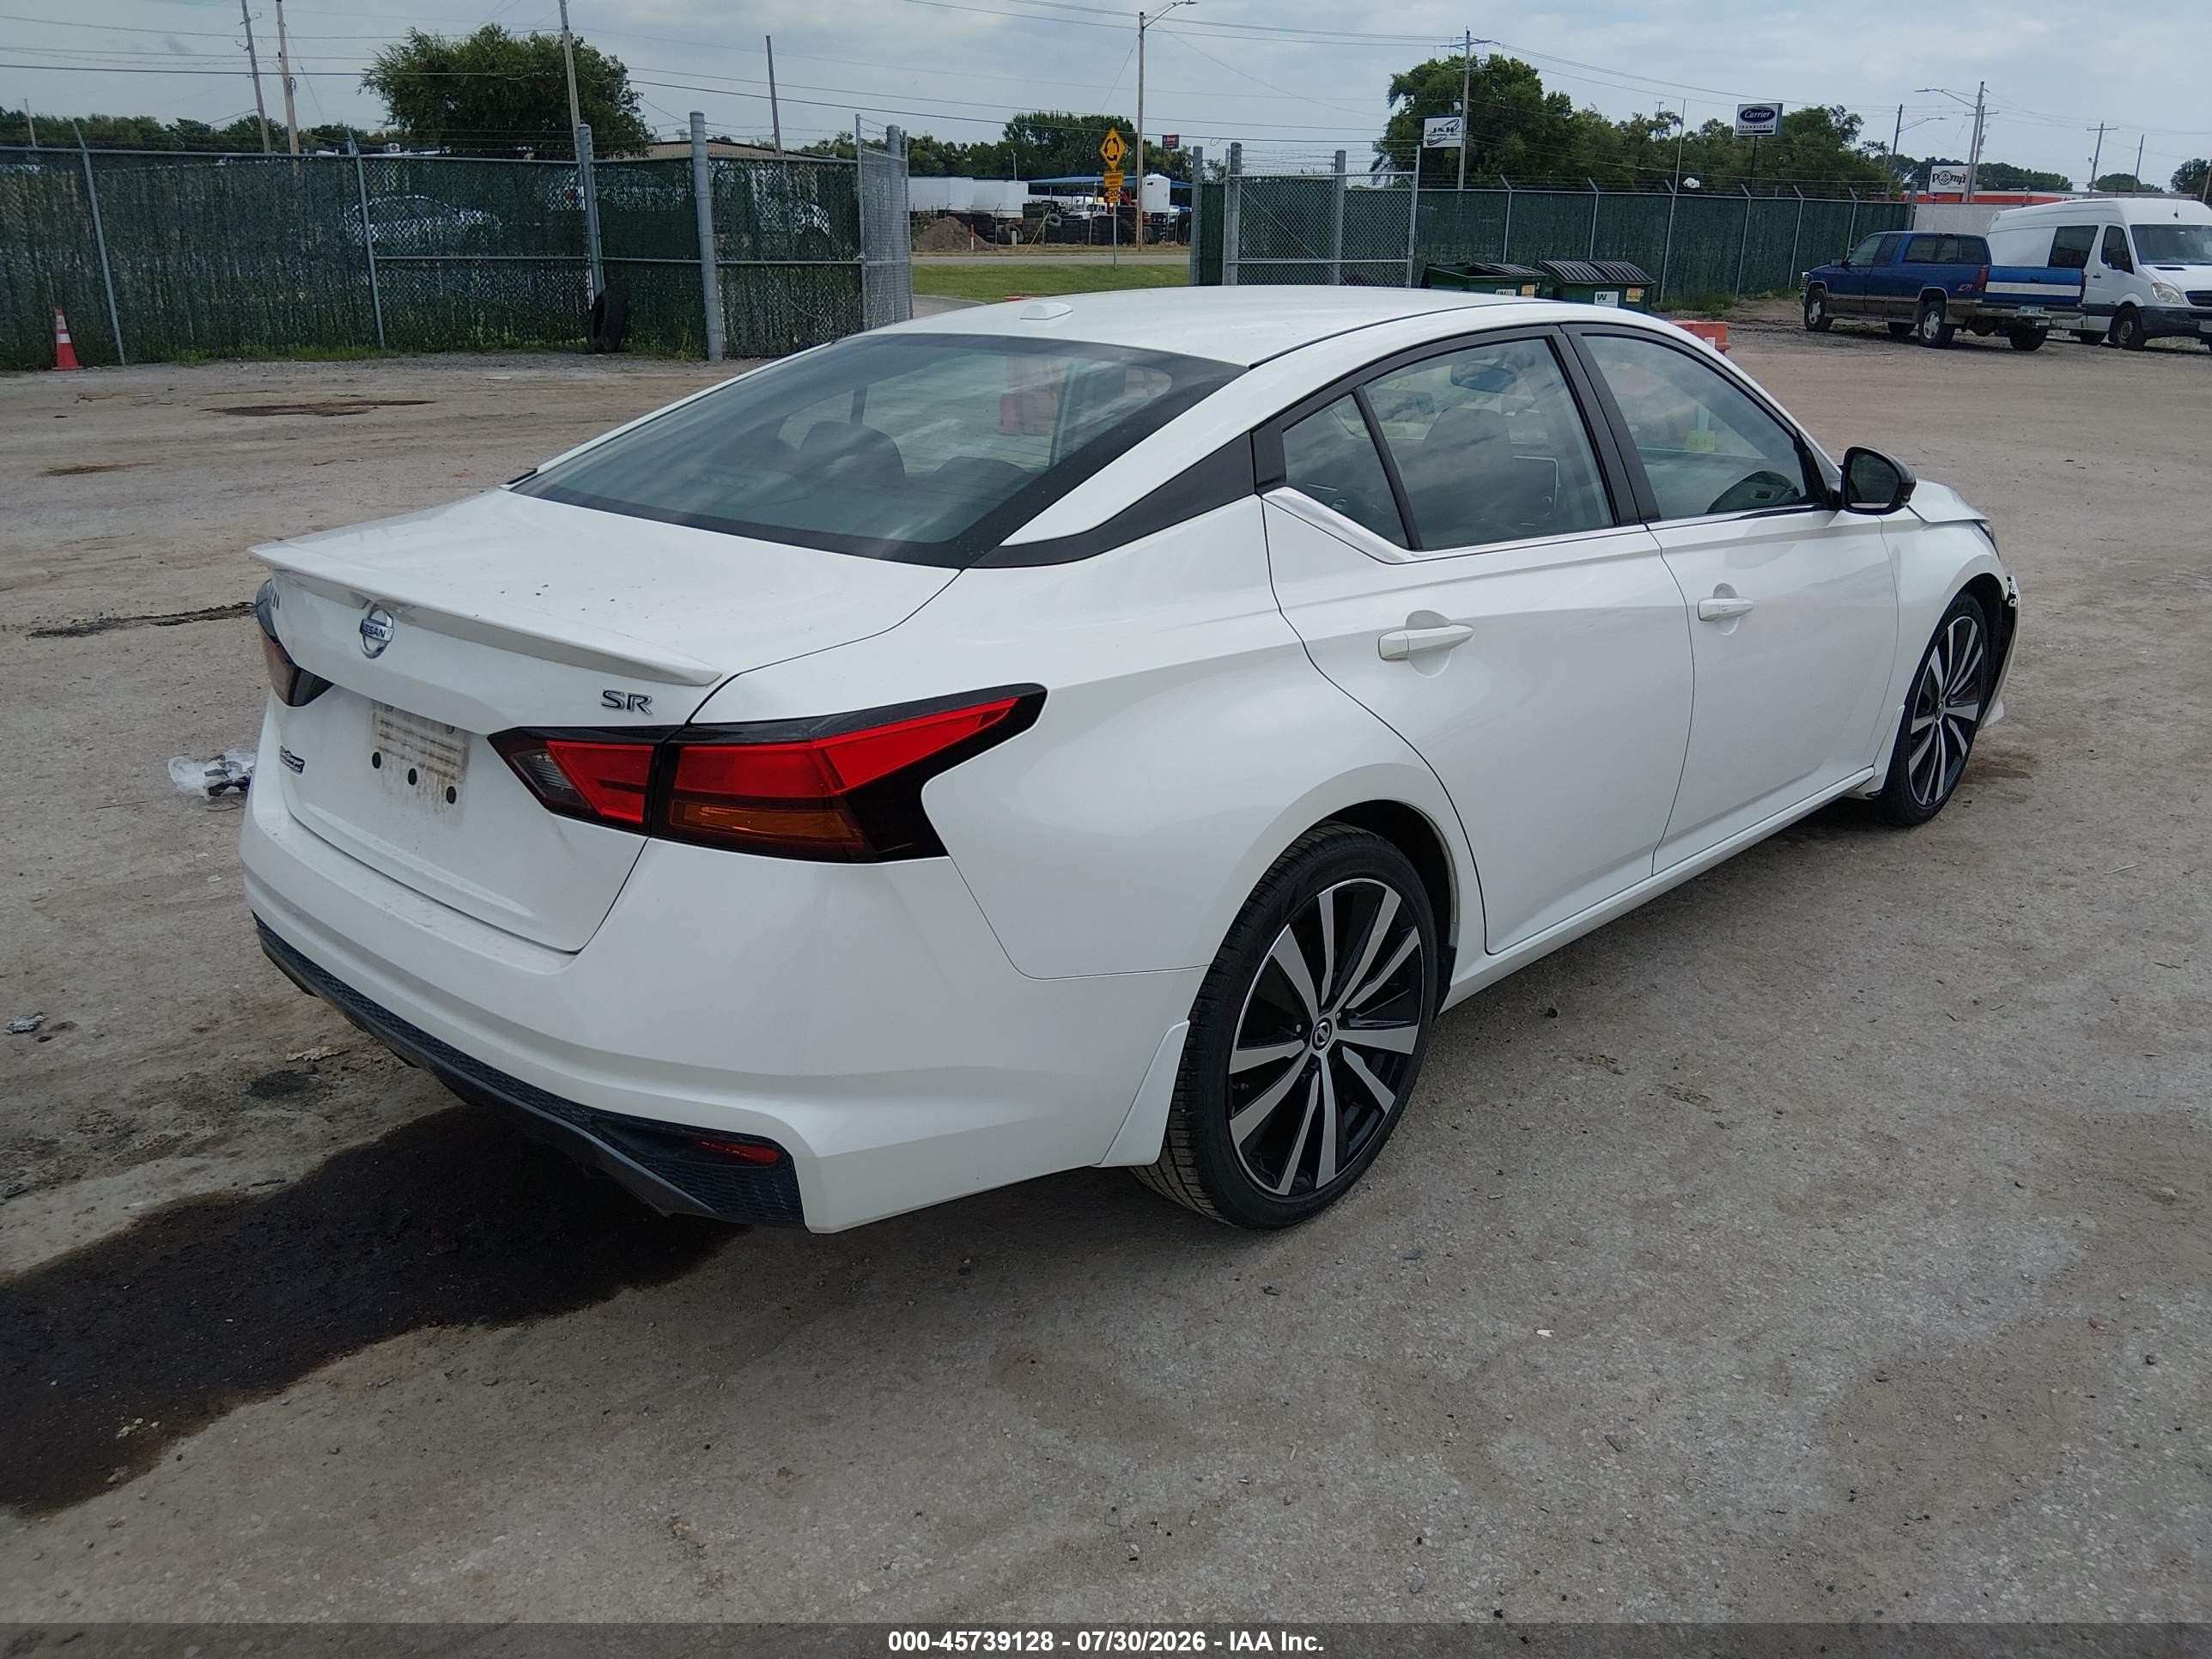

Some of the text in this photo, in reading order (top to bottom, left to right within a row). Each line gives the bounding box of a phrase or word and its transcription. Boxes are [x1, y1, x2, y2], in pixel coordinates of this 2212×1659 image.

[1109, 189, 1118, 198] 20
[362, 624, 386, 638] SSAN
[601, 690, 653, 714] SR
